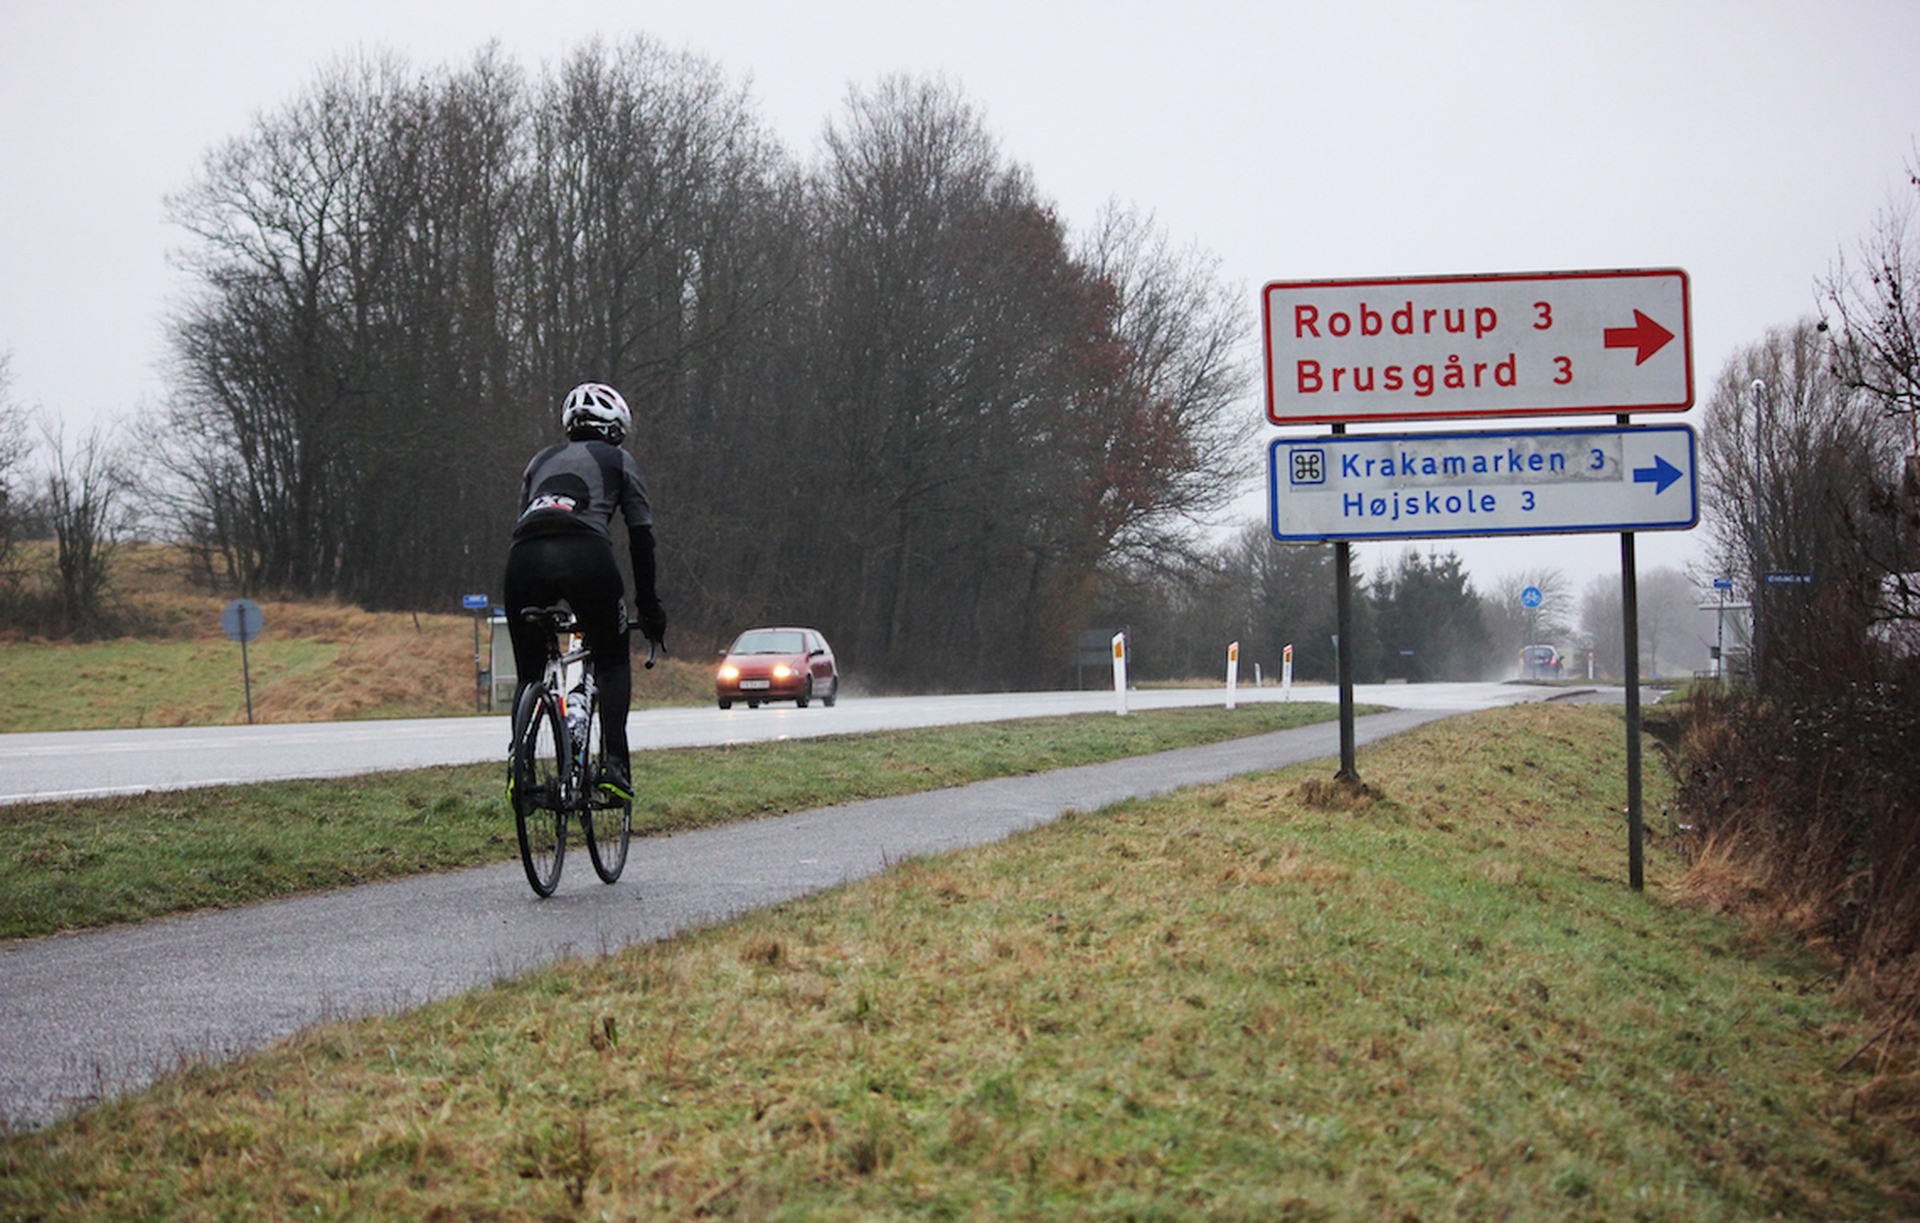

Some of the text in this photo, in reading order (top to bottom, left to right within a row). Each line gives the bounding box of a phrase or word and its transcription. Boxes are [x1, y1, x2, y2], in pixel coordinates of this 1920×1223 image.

[1294, 301, 1554, 339] Robdrup 3
[1297, 353, 1574, 397] Brusgård 3
[1341, 448, 1606, 479] Krakamarken 3
[1342, 488, 1537, 521] Højskole 3
